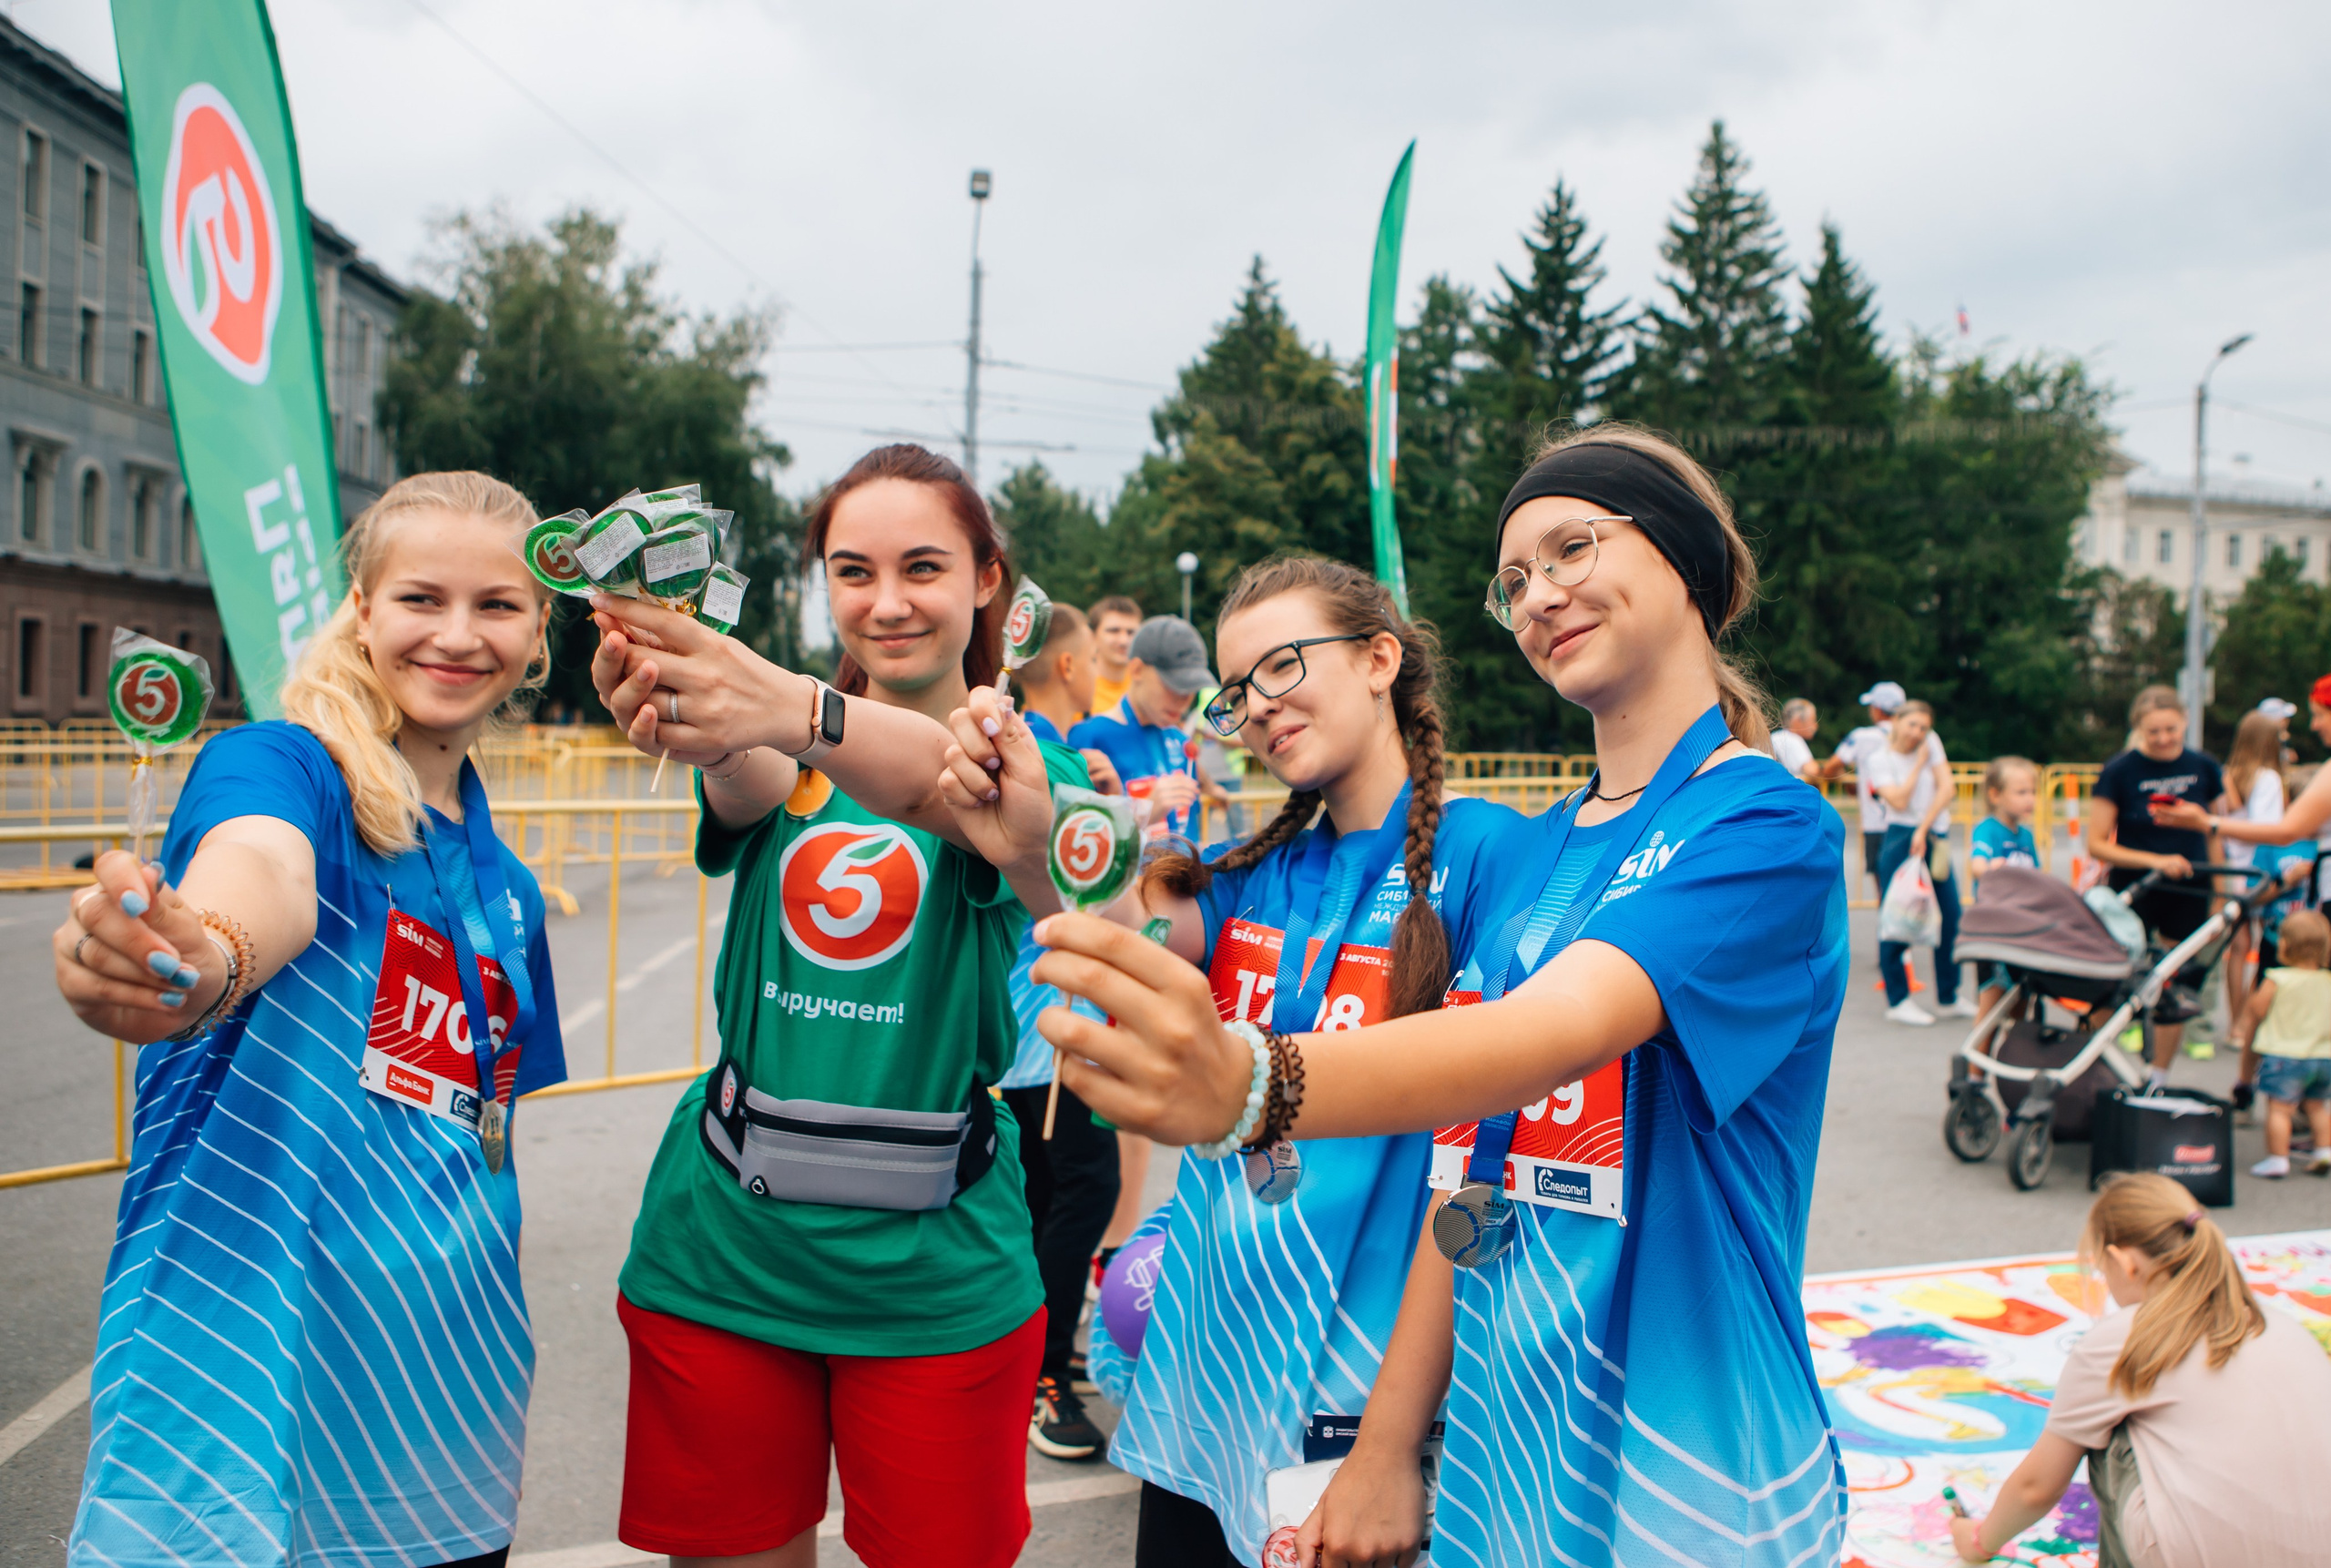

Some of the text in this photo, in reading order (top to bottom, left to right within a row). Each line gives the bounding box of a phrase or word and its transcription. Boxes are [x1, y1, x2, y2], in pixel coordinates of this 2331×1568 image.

[135, 667, 170, 717] 5
[1069, 819, 1104, 872] 5
[808, 835, 897, 939] 5
[1543, 1177, 1588, 1197] Следопыт
